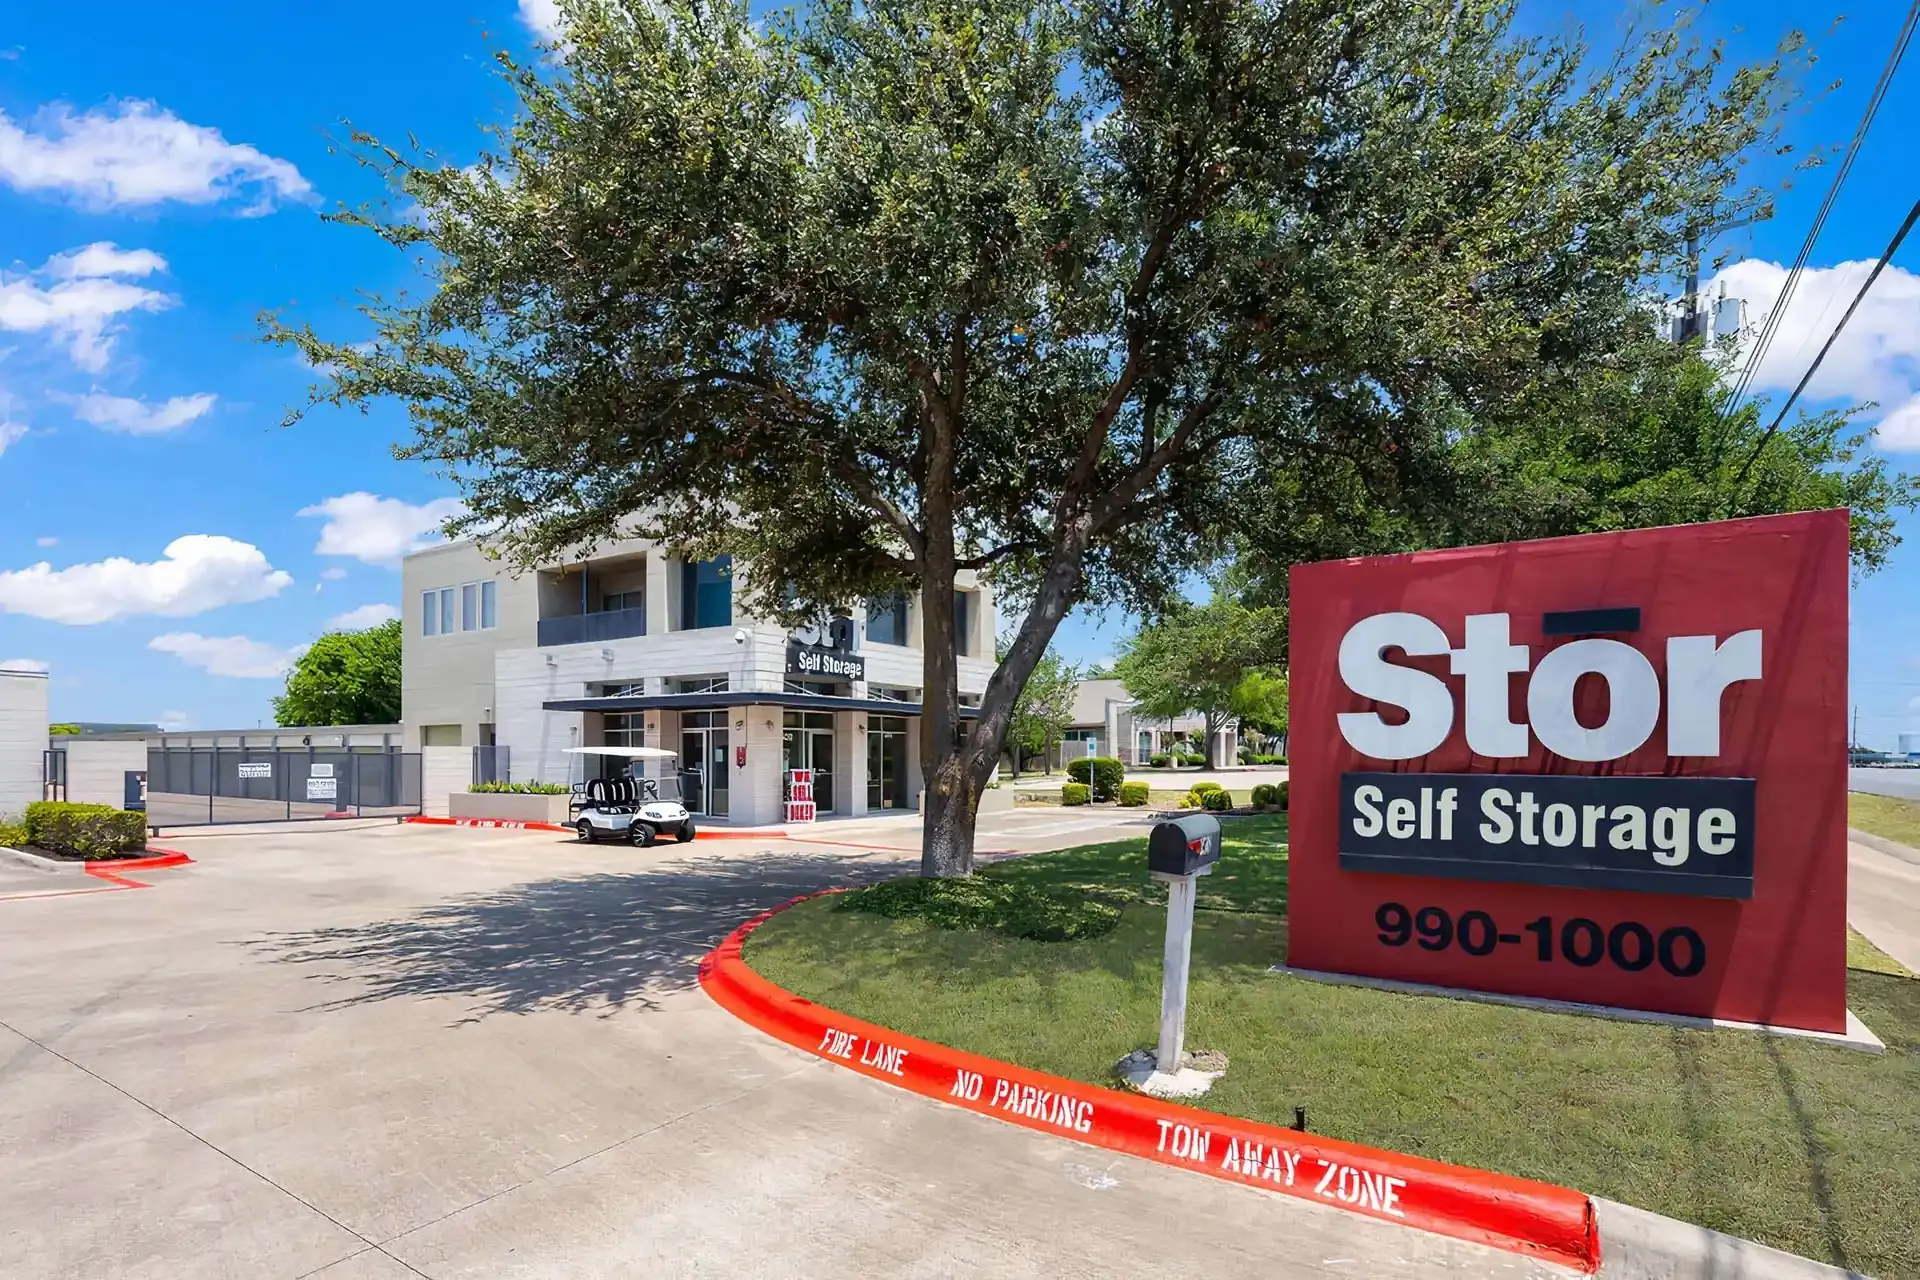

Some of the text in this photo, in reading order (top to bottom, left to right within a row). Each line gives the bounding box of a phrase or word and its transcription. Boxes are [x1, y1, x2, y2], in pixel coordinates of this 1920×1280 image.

[798, 651, 862, 679] Self Storage
[1353, 785, 1736, 866] Self Storage
[1375, 902, 1707, 978] 990-1000
[819, 1028, 908, 1076] FIRE LANE
[950, 1069, 1094, 1132] NO PARKING
[1156, 1119, 1407, 1218] TOW AWAY ZONE
